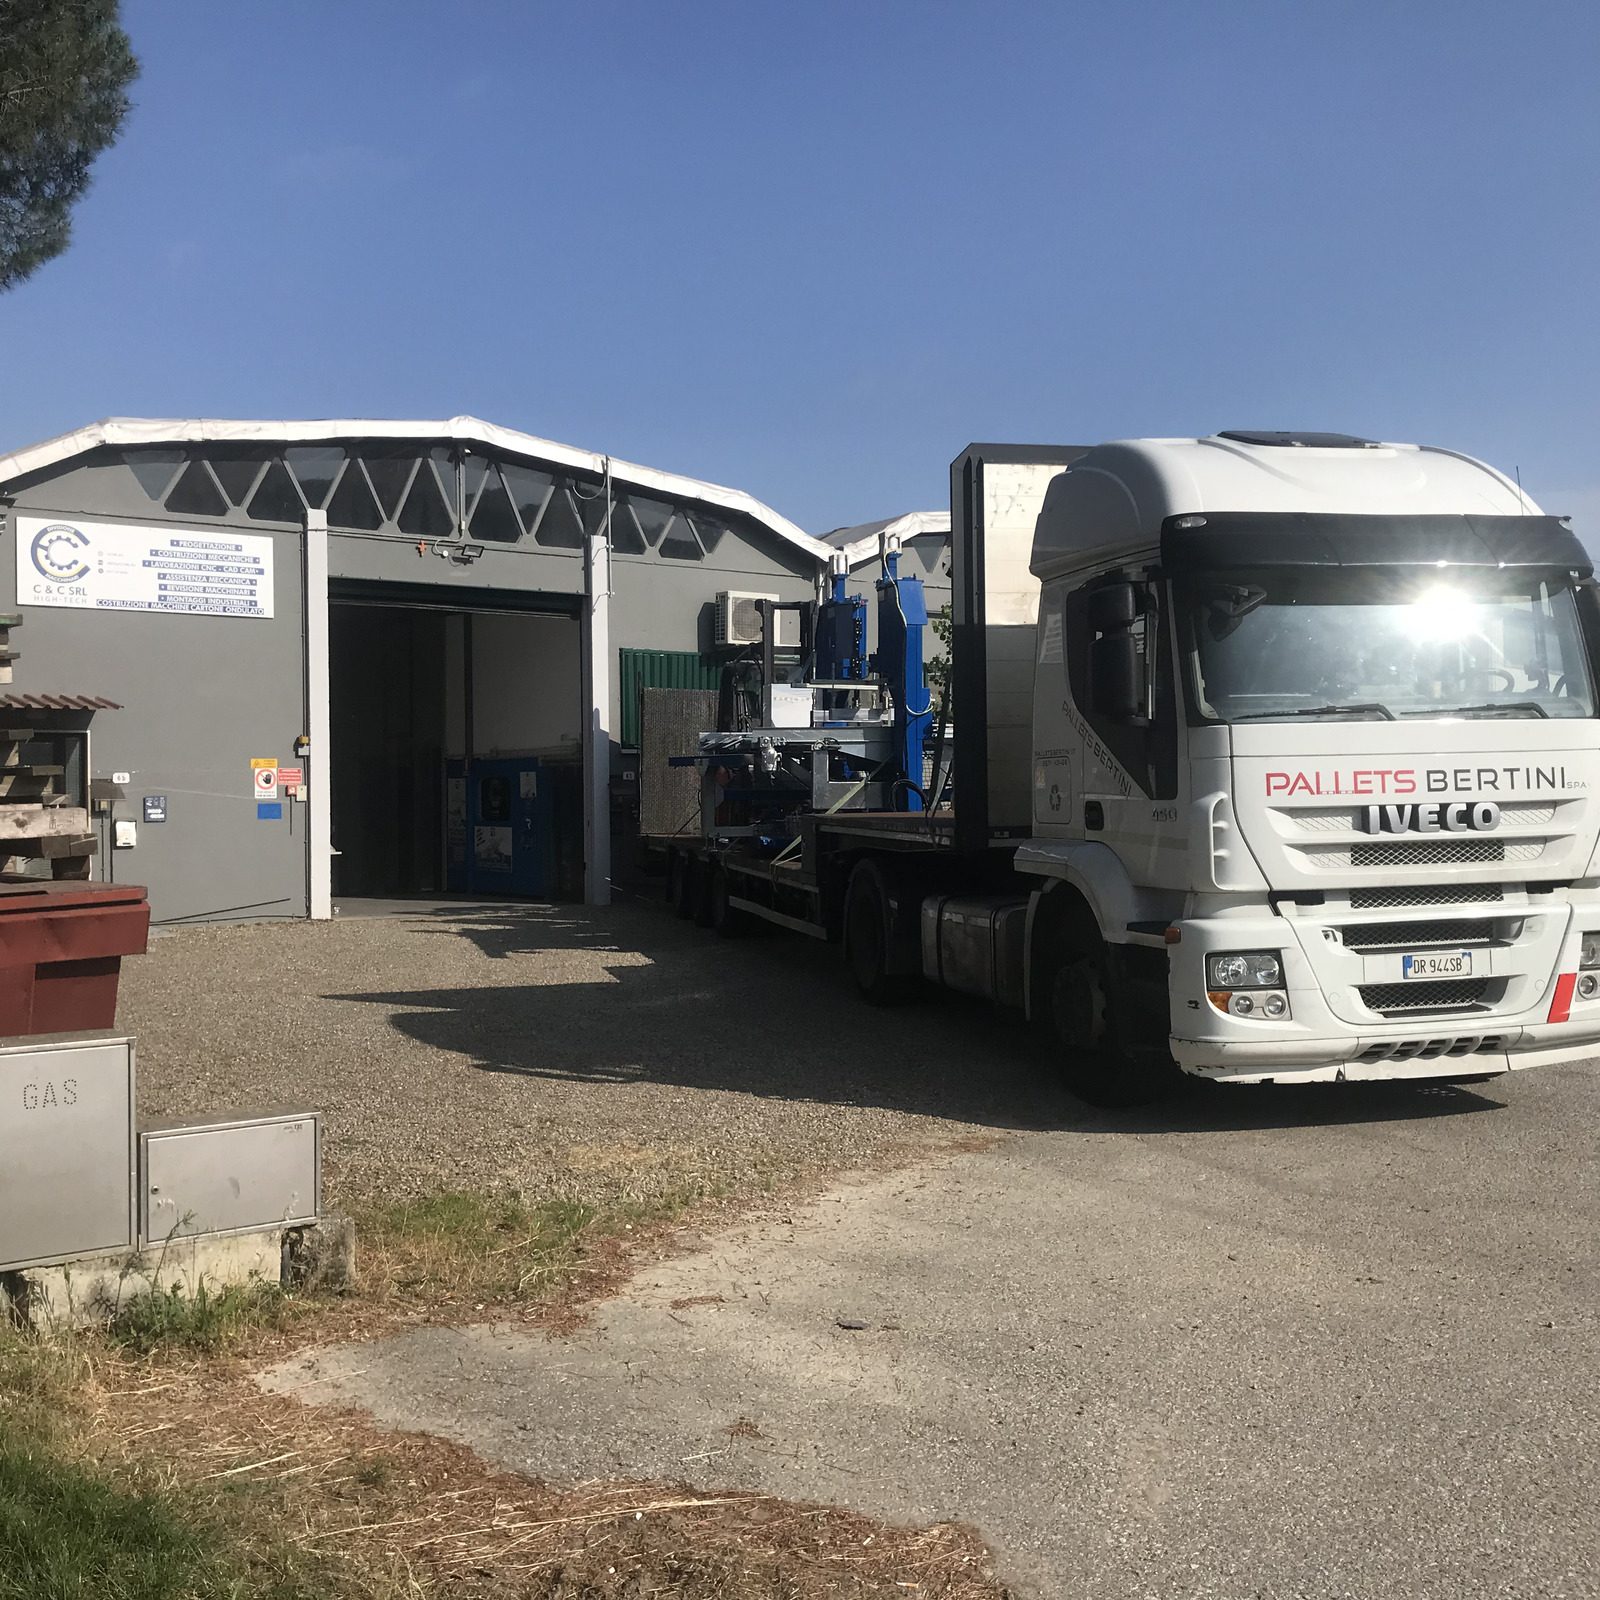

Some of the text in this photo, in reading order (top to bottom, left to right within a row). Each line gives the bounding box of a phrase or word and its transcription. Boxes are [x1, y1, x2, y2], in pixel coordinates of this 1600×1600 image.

[179, 540, 236, 551] PROGETTAZIONE
[157, 549, 254, 564] COSTRUZIONI MECCANICHE
[150, 560, 200, 571] LAVORAZIONI
[200, 564, 217, 573] CNC
[223, 566, 239, 574] CAD
[239, 567, 256, 575] CAM
[165, 573, 251, 586] ASSISTENZA MECCANICA
[33, 584, 88, 597] C & C SRL
[166, 584, 250, 596] REVISIONE MACCHINARI
[33, 595, 87, 604] HIGH-TECH
[97, 599, 264, 615] COSTRUZIONE MACCHINE CARTONE ONDULATO
[166, 595, 250, 606] MONTAGGI INDUSTRIALI
[1093, 745, 1132, 799] BERTINI
[1265, 769, 1417, 797] PALLETS
[1426, 766, 1566, 793] BERTINI
[1364, 801, 1501, 834] IVECO
[1413, 957, 1463, 974] DR 944SB
[23, 1079, 77, 1110] GAS
